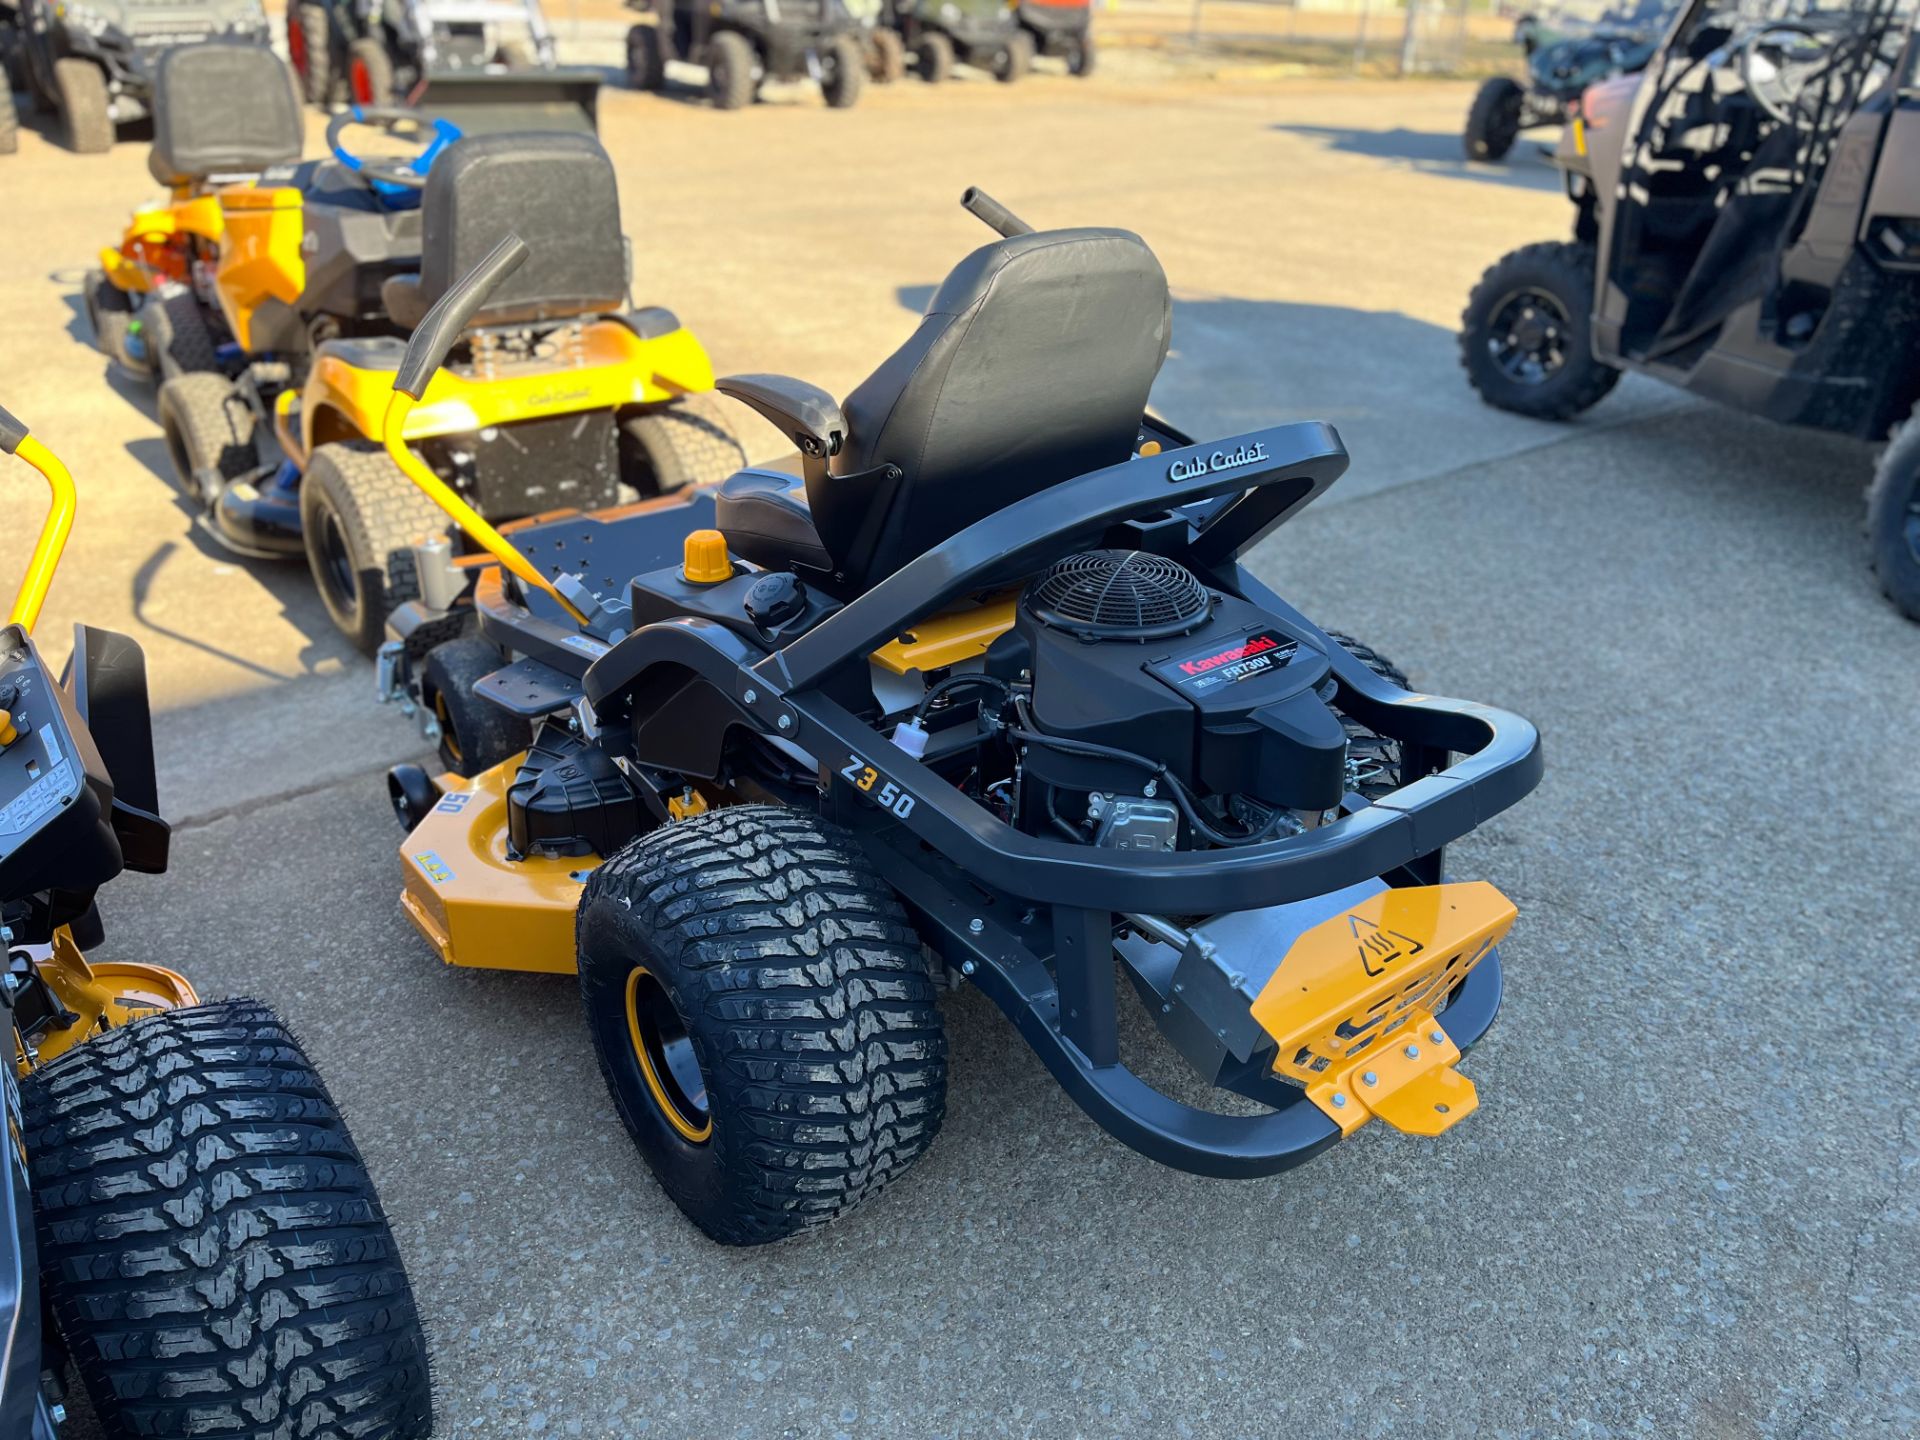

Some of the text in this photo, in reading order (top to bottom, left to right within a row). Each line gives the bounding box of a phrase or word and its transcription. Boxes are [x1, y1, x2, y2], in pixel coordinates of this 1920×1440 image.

[1170, 442, 1266, 482] Cub Cadet
[1179, 635, 1278, 676] Kawasaki
[1222, 655, 1271, 679] FR730V
[437, 792, 472, 813] 50
[841, 754, 916, 819] Z3 50
